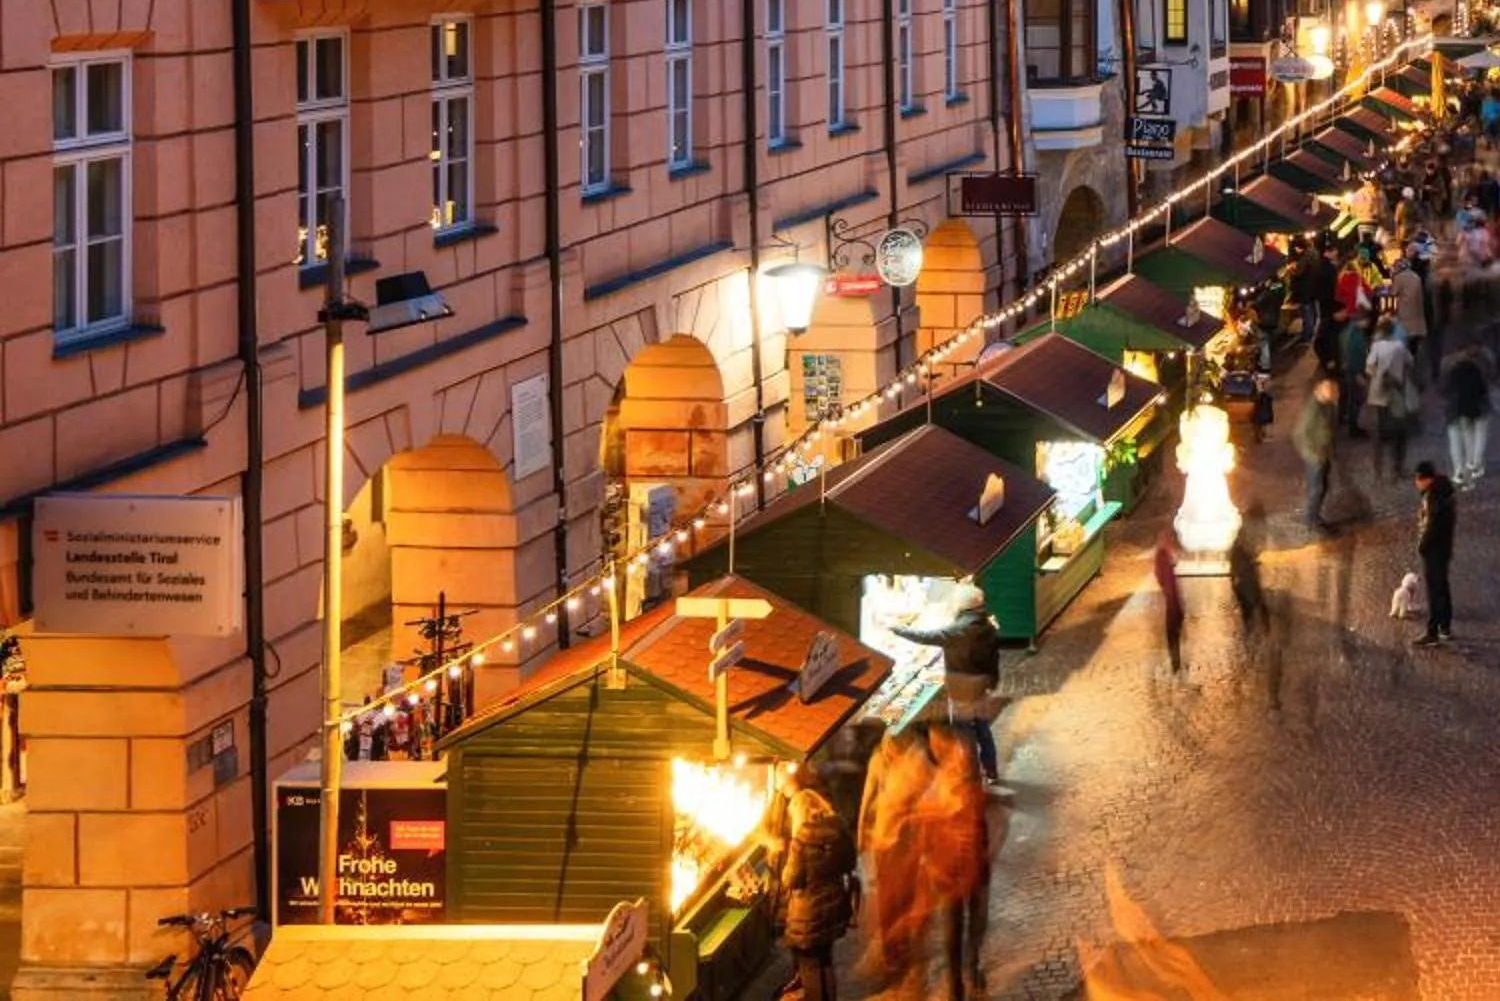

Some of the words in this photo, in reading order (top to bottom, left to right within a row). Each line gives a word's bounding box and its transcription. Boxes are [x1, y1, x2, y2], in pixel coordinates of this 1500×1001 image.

[1133, 118, 1169, 136] Piano
[66, 530, 221, 546] Sozialministeriumservice
[65, 551, 146, 564] Landesstelle
[150, 551, 178, 565] Tirol
[65, 571, 132, 584] Bundesamt
[137, 572, 152, 585] für
[157, 573, 206, 586] Soziales
[65, 589, 89, 601] und
[92, 588, 203, 603] Behindertenwesen
[338, 854, 397, 874] Frohe
[300, 876, 435, 897] Whnachten
